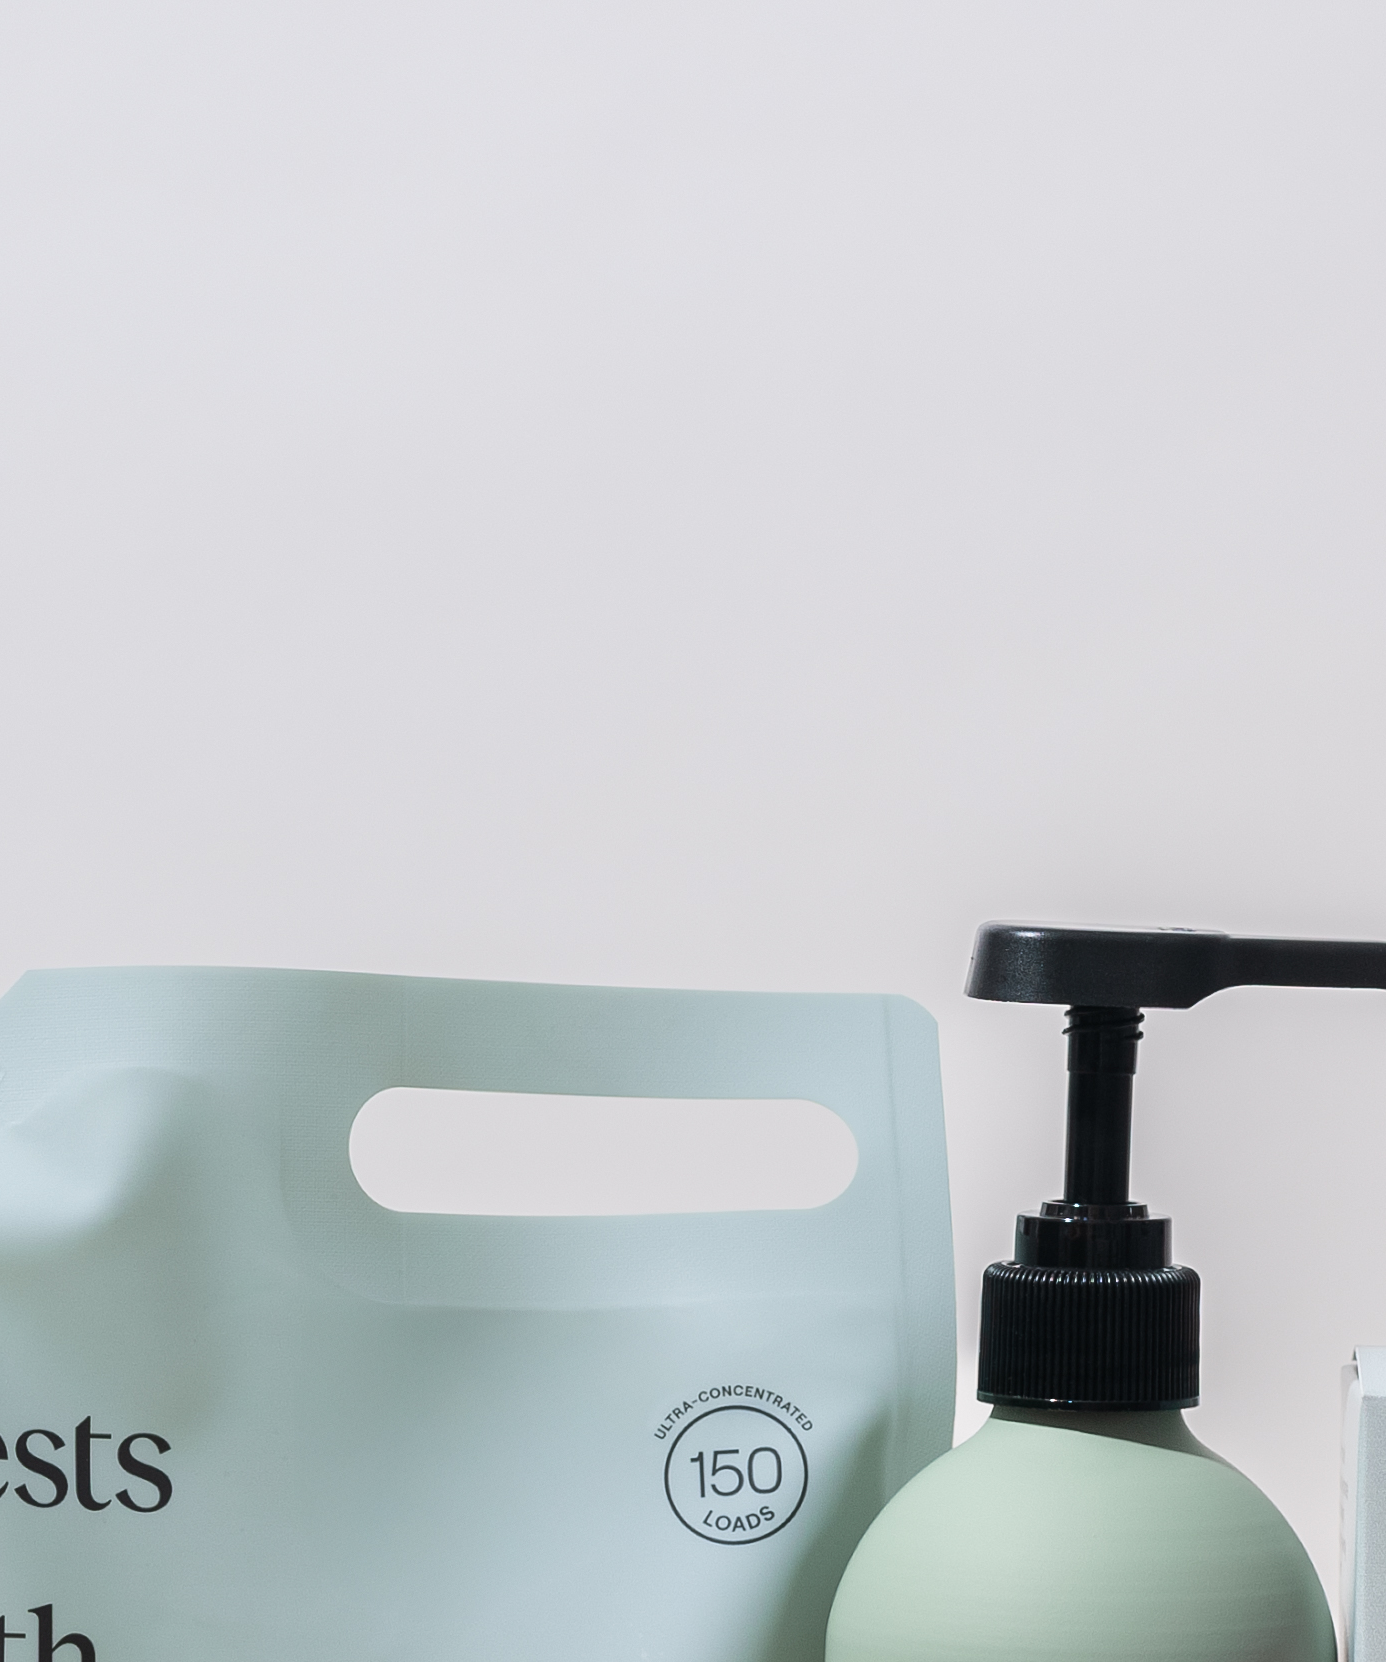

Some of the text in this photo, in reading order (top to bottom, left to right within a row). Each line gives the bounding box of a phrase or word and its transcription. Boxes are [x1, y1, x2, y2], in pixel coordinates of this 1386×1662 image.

[654, 1385, 813, 1440] ULTRA-CONCENTRATED
[690, 1446, 783, 1498] 150
[702, 1505, 775, 1533] LOADS
